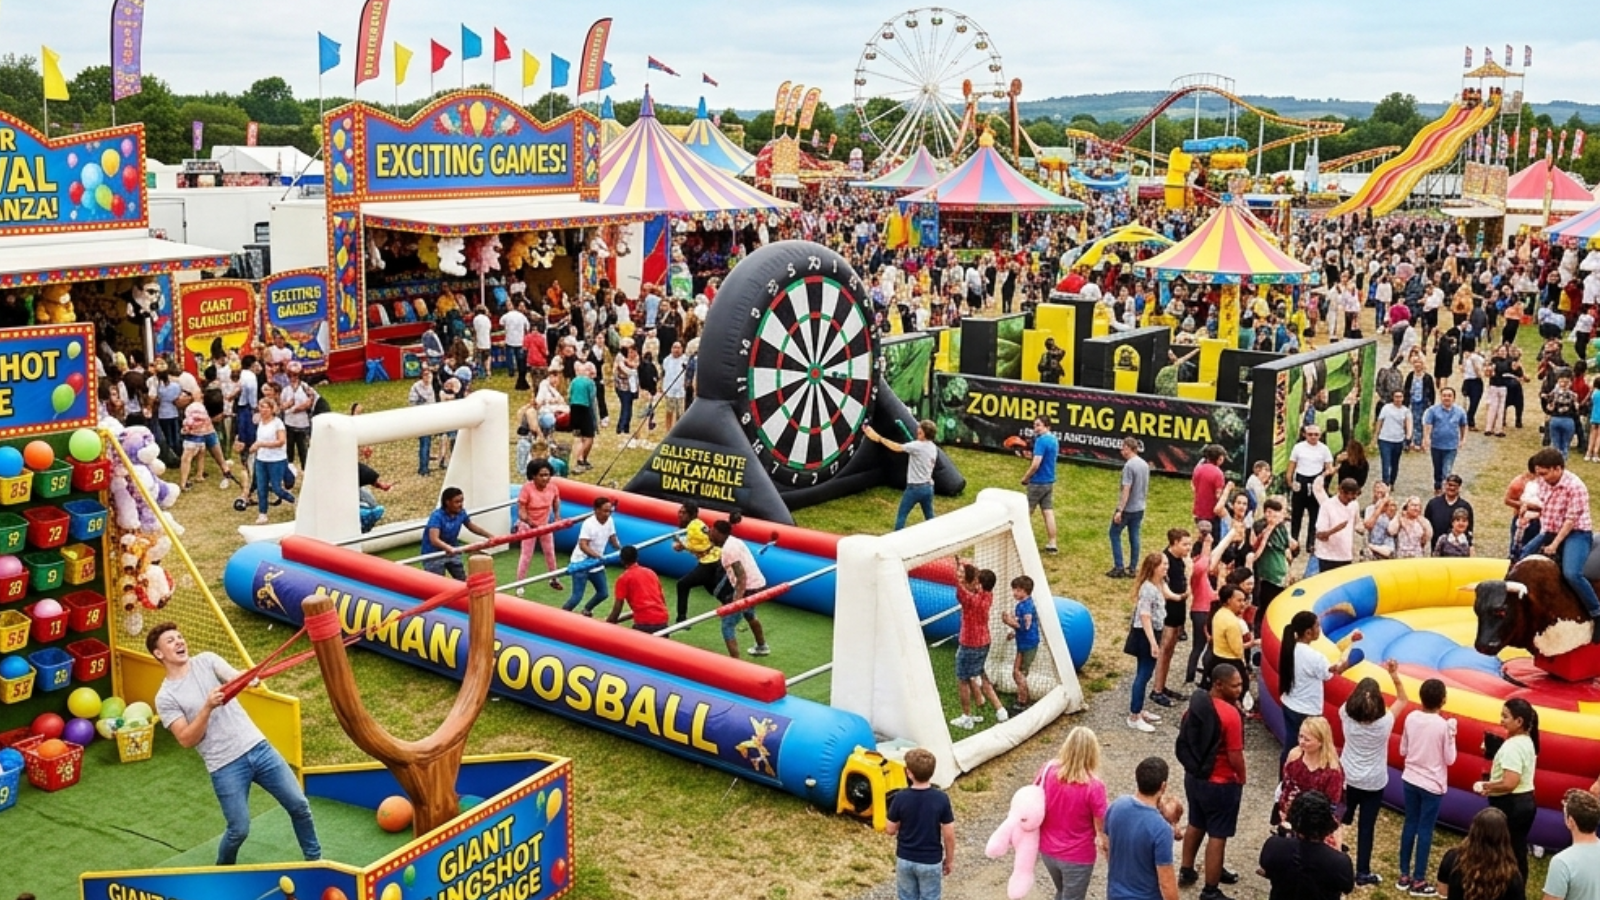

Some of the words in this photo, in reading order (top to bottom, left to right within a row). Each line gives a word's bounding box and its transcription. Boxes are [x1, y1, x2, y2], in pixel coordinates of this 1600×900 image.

[376, 145, 484, 177] EXCITING
[490, 144, 567, 175] GAMES!
[966, 391, 1060, 424] ZOMBIE
[1067, 403, 1114, 432] TAG
[1121, 410, 1212, 443] ARENA
[315, 586, 462, 669] UMAN
[494, 641, 718, 755] OOSBALL
[440, 815, 514, 883] GIANT
